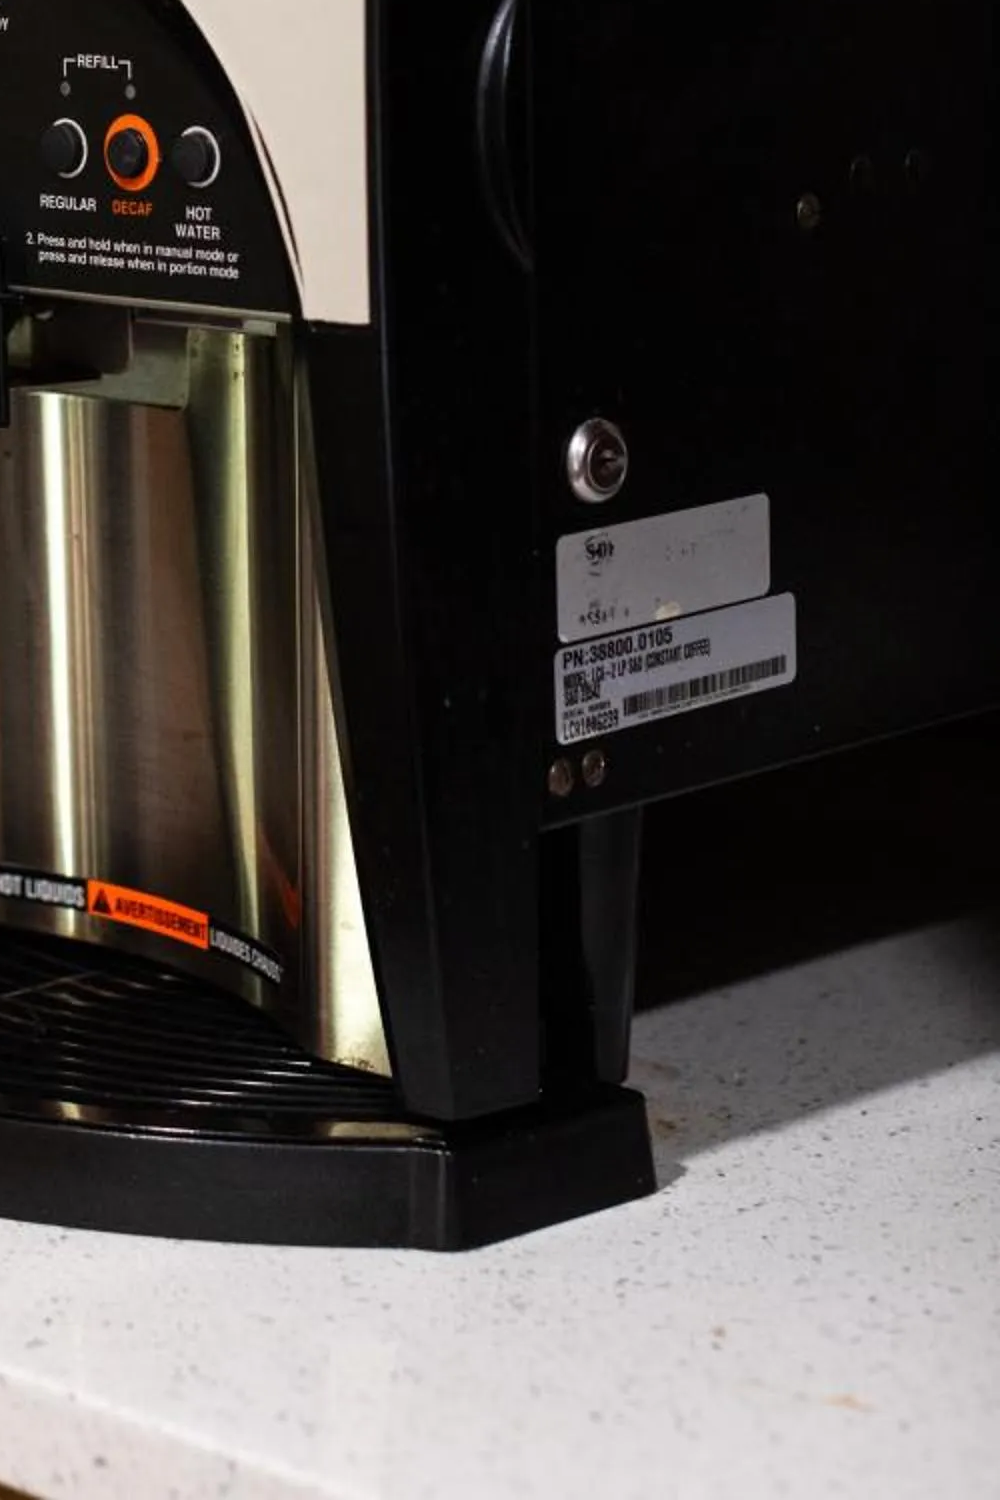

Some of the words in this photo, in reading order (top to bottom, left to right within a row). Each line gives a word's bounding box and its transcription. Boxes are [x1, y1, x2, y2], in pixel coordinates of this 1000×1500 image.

[77, 54, 119, 69] REFILL
[40, 193, 97, 212] REGULAR
[112, 199, 153, 216] DECAF
[185, 206, 212, 221] HOT
[175, 223, 221, 240] WATER
[37, 233, 65, 247] Press
[67, 236, 87, 249] and
[88, 237, 110, 251] hold
[113, 240, 140, 254] when
[143, 241, 152, 255] in
[155, 244, 193, 259] manual
[195, 248, 224, 262] mode
[227, 252, 240, 263] or
[38, 251, 65, 263] press
[67, 252, 87, 265] and
[89, 254, 125, 268] release
[127, 257, 155, 271] when
[157, 259, 167, 272] in
[169, 261, 207, 276] portion
[209, 265, 239, 279] mode
[562, 626, 673, 670] PN:38800.0105
[24, 876, 85, 908] LIQUIDS
[115, 897, 207, 942] AVERTISSEMENT
[210, 926, 251, 963] LIQUIDES
